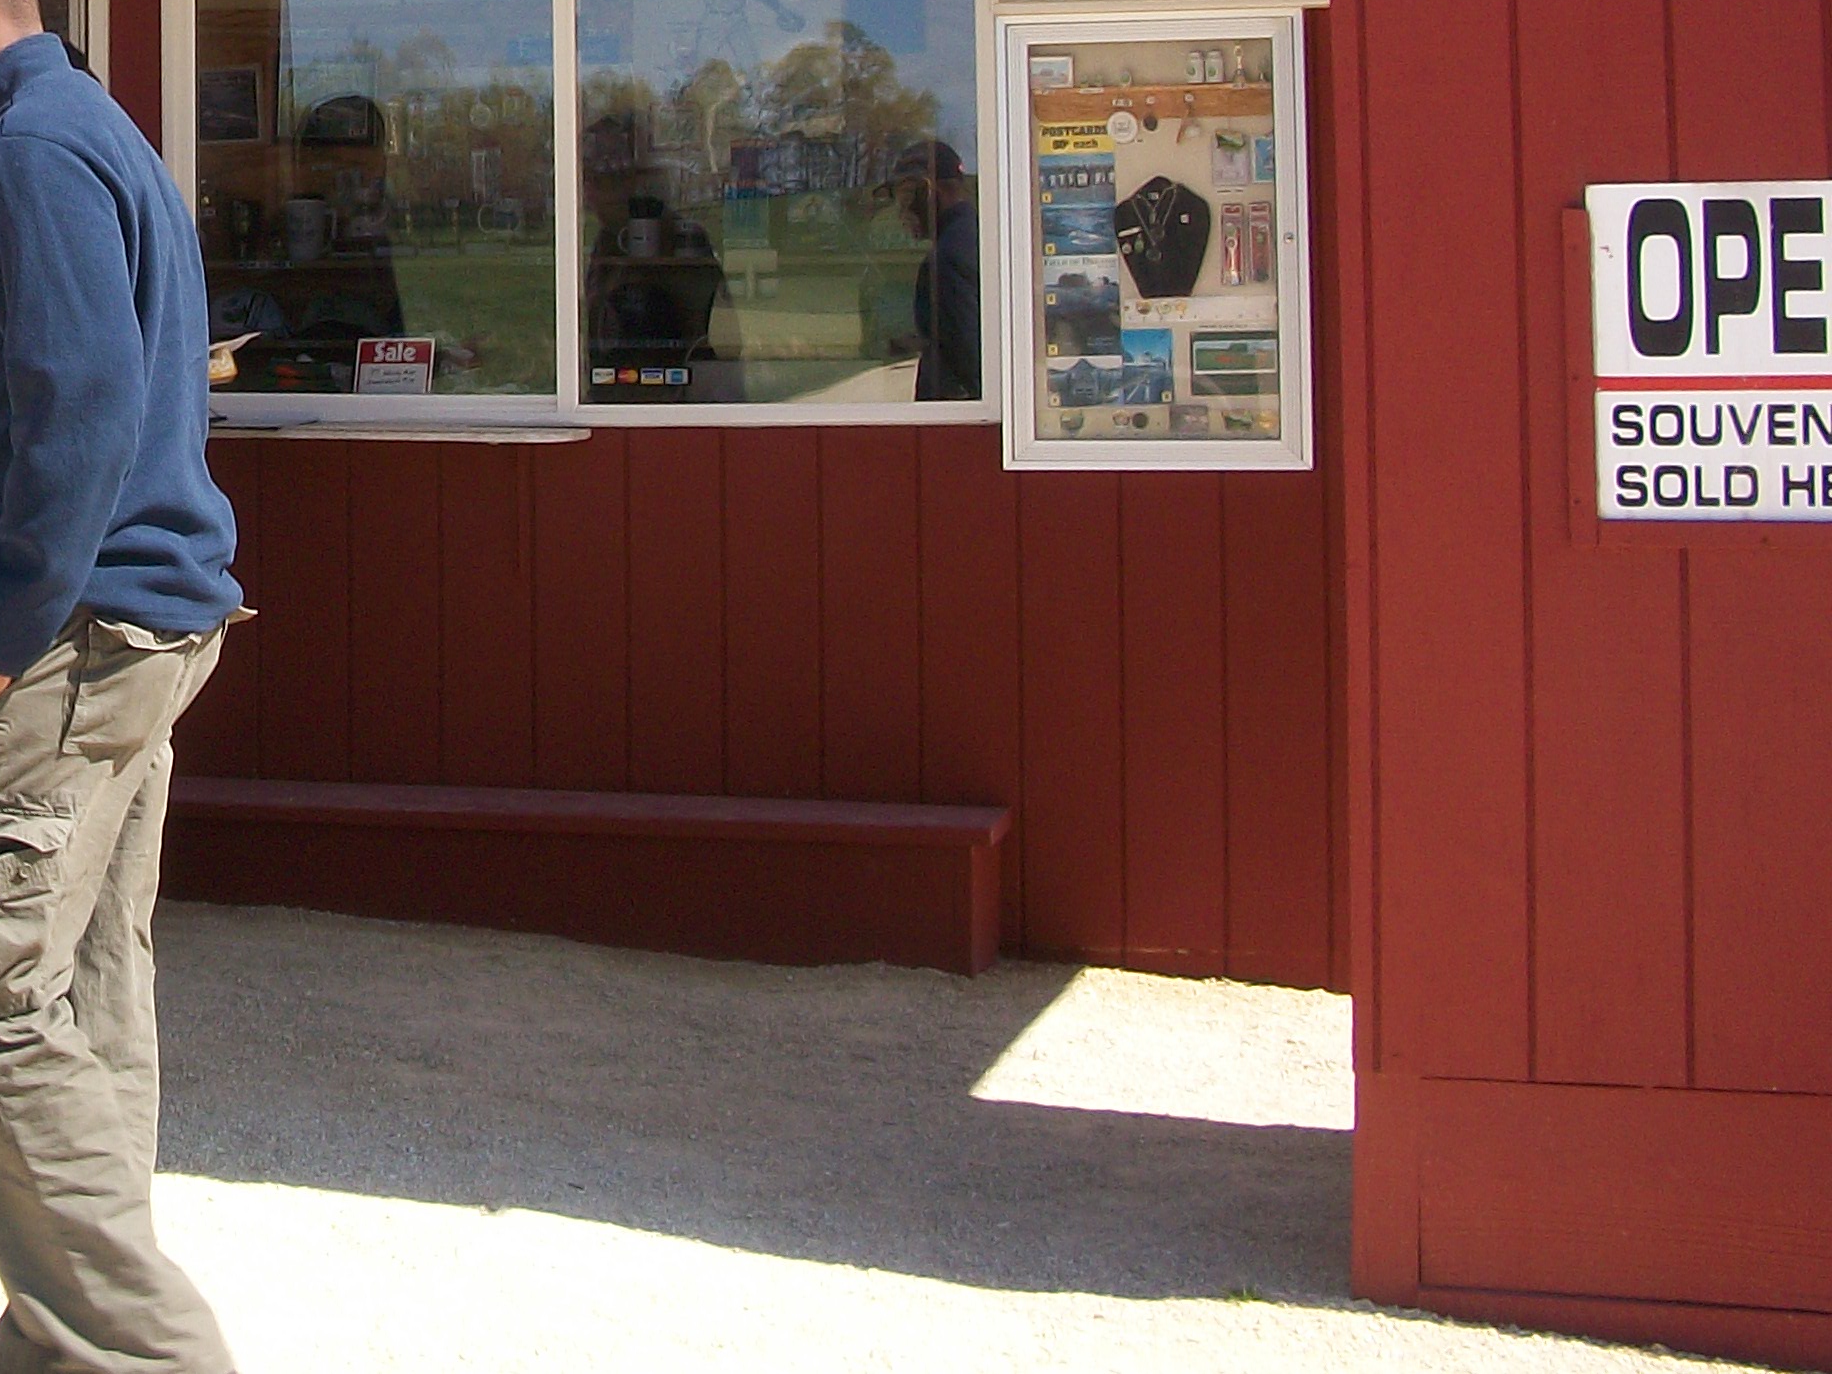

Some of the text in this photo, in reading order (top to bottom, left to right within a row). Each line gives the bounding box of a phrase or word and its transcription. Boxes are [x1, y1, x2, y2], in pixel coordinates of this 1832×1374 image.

[1626, 196, 1829, 357] OPE
[373, 341, 417, 363] Sale
[1611, 403, 1832, 446] SOUVEN
[1615, 464, 1760, 508] SOLD
